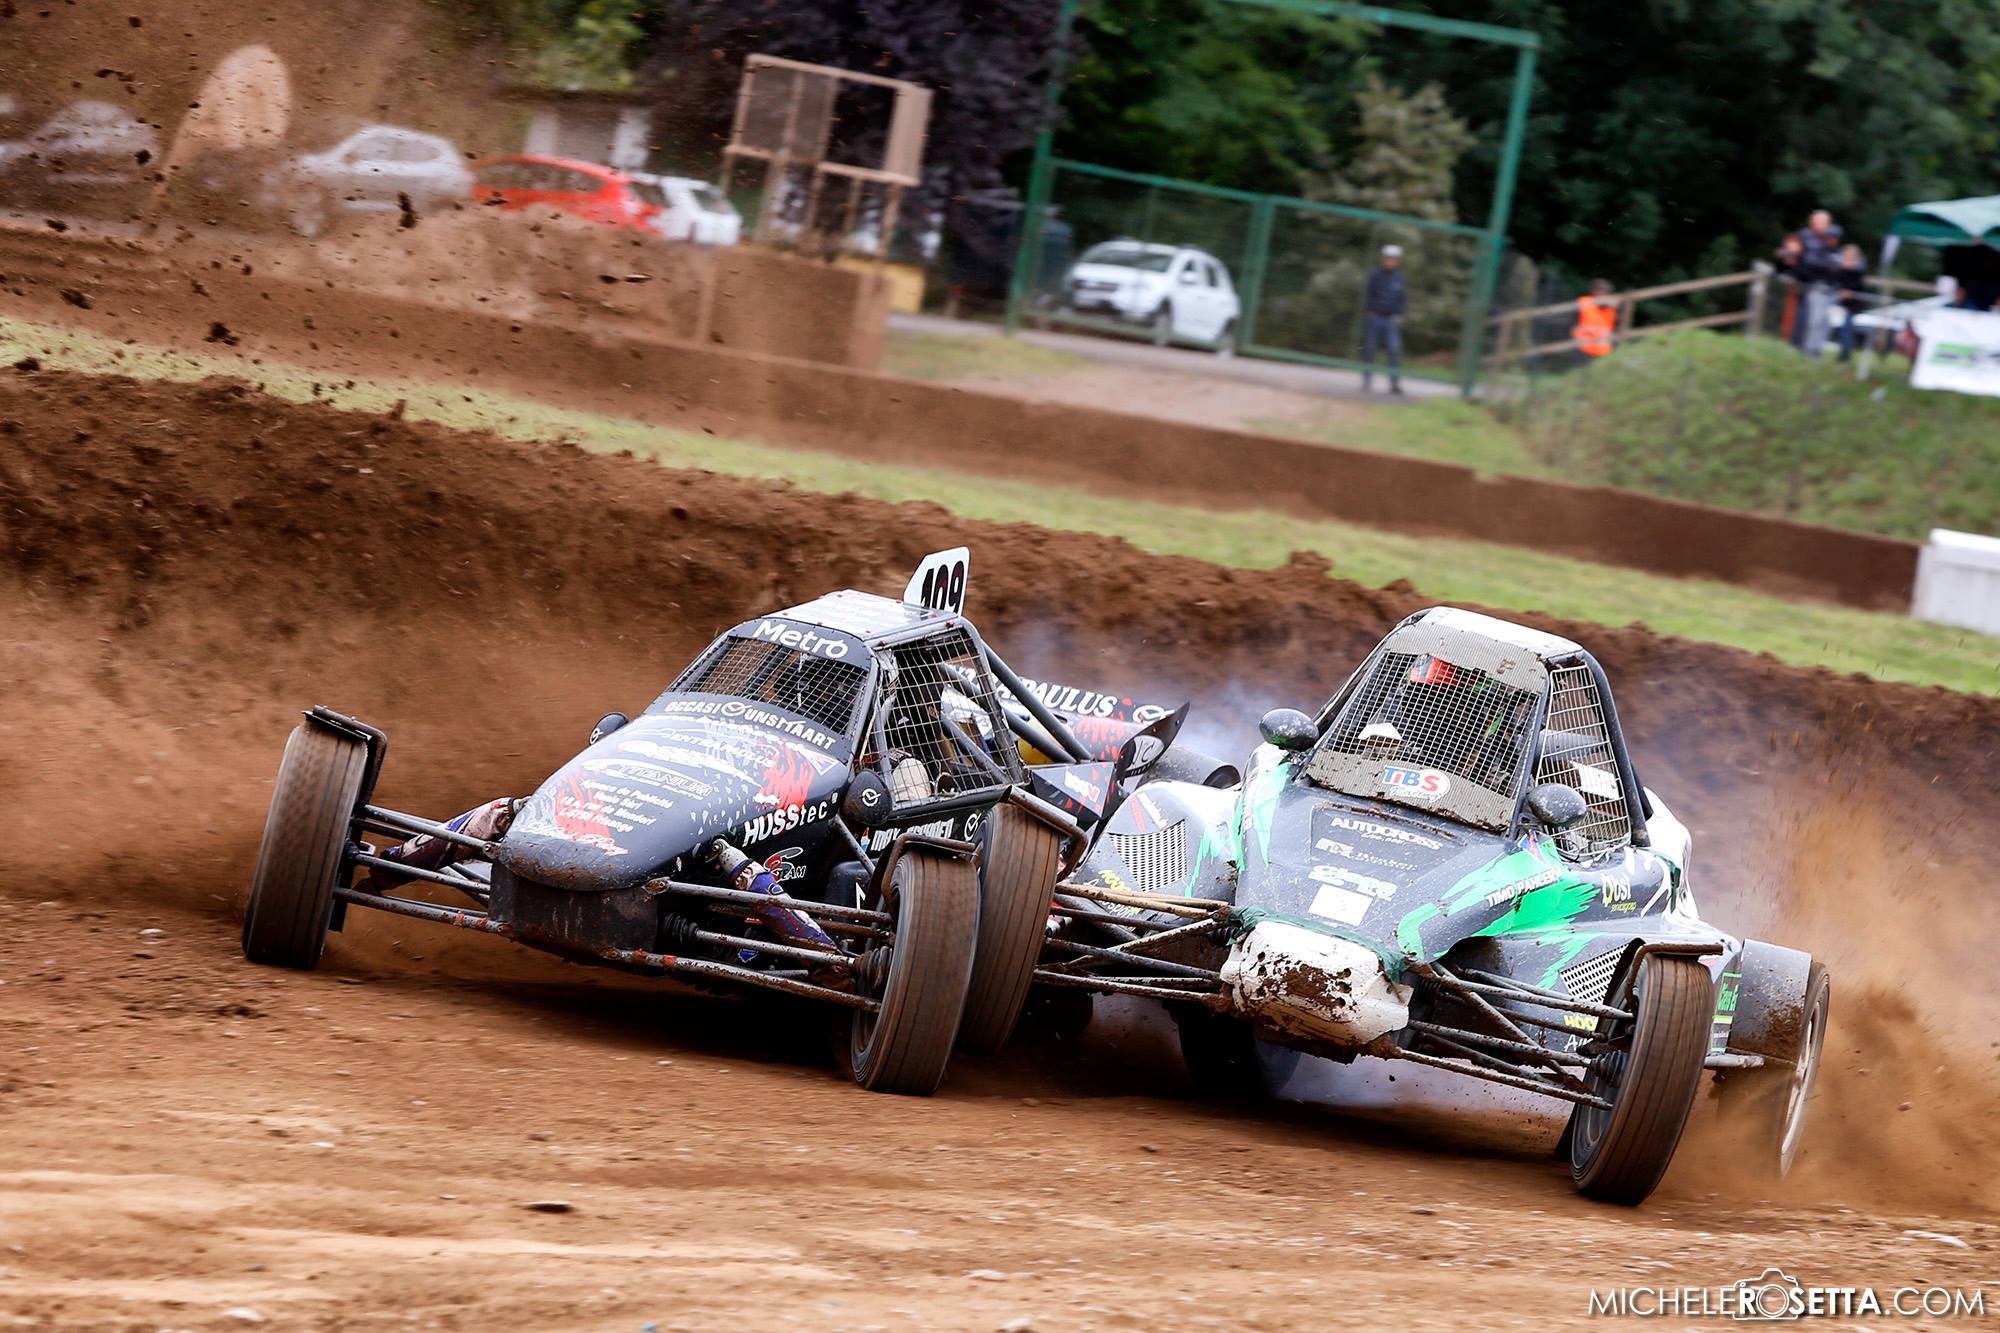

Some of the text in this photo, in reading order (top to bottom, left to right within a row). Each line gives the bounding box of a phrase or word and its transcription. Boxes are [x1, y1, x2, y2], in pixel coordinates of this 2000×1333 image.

[752, 619, 849, 659] Metro
[1330, 817, 1444, 850] AUTOCROSS
[1486, 884, 1515, 908] TIMO
